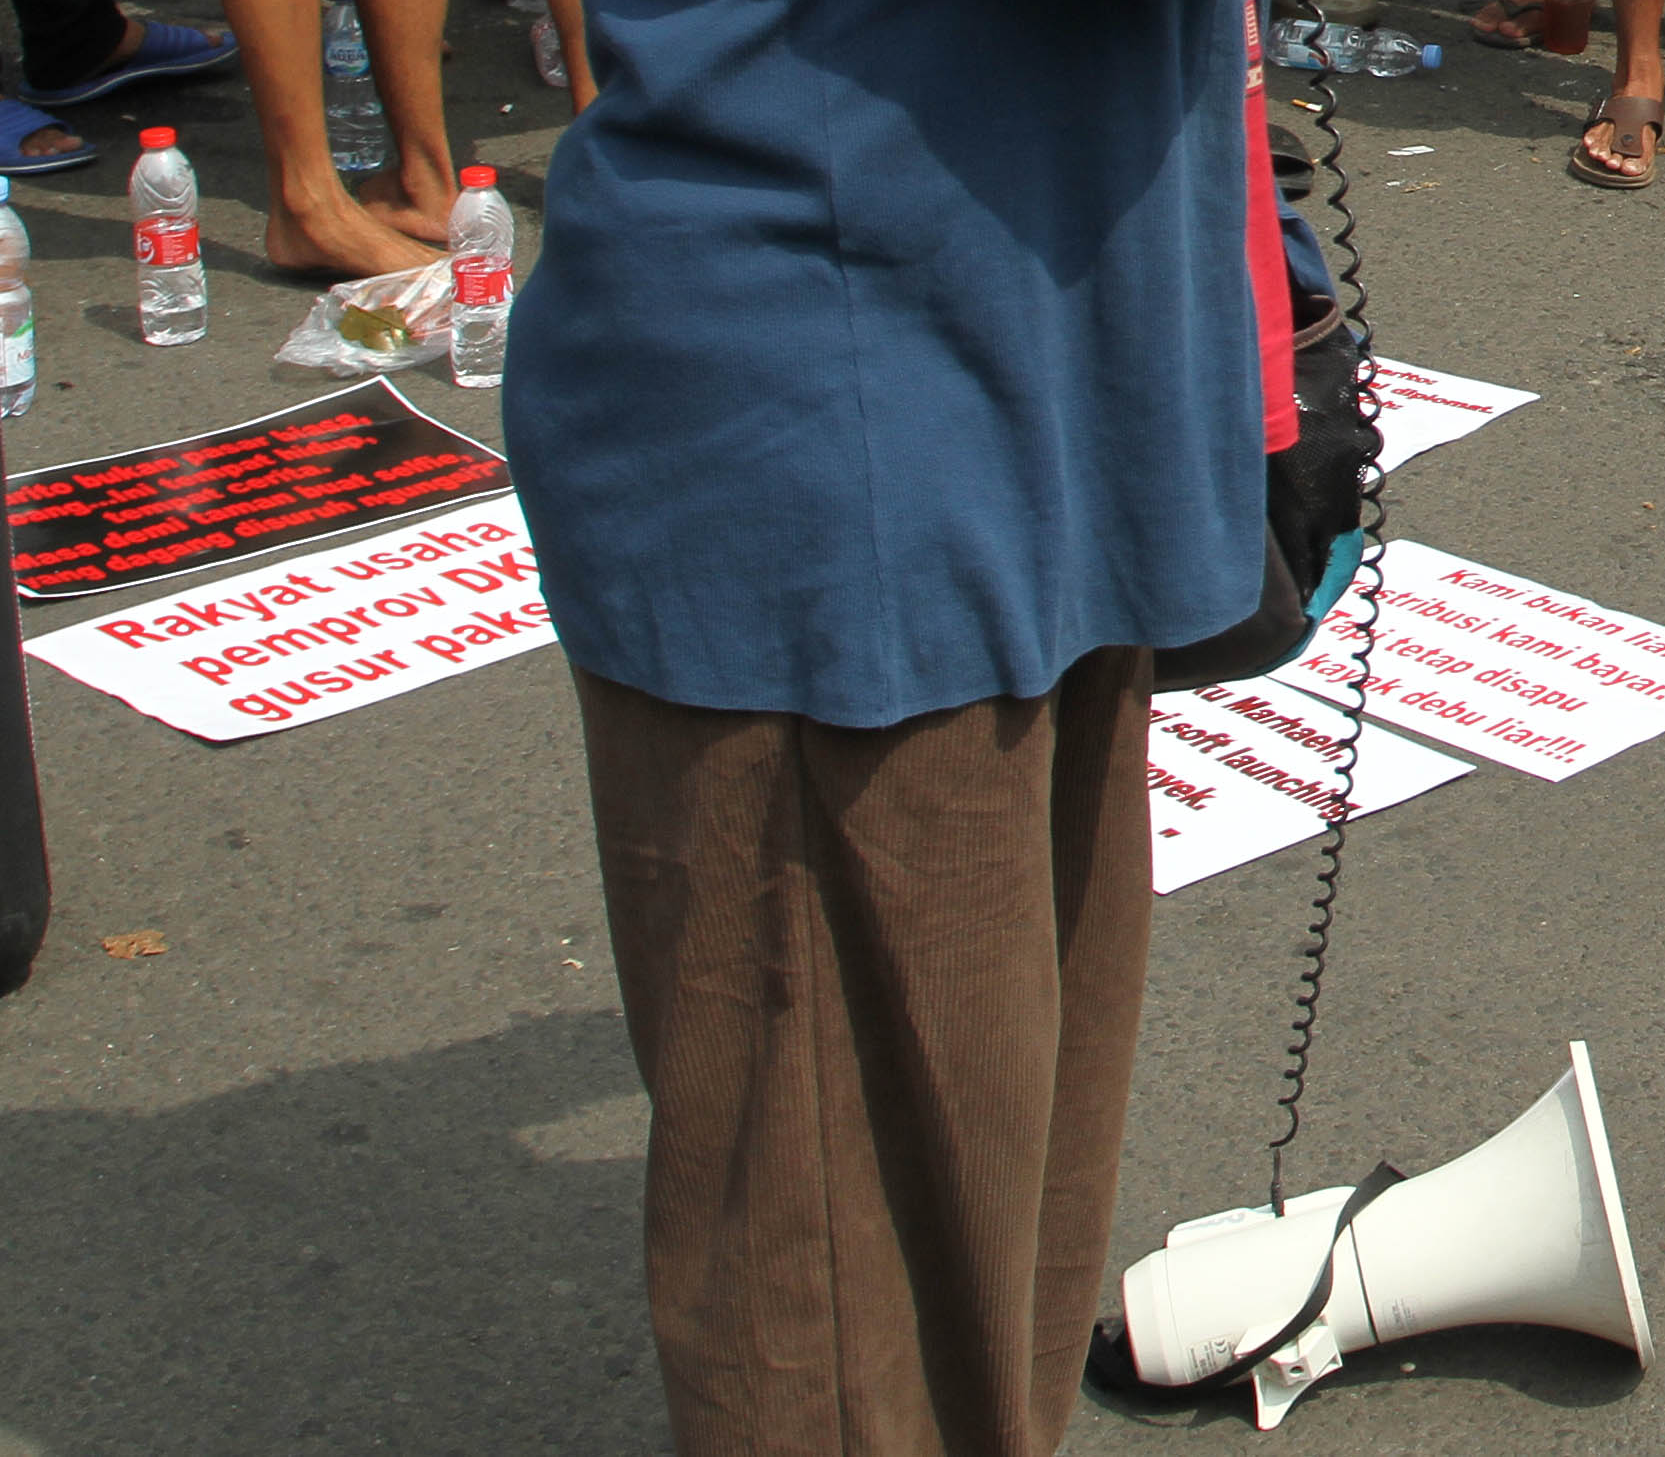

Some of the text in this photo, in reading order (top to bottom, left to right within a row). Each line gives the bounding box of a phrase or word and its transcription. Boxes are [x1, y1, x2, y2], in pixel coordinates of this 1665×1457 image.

[72, 458, 181, 489] bukan
[181, 436, 270, 467] pasar
[102, 464, 332, 524] tempat cerita.
[157, 454, 276, 490] tempat
[103, 516, 190, 549] demi
[188, 492, 297, 525] taman
[293, 472, 374, 499] buat
[106, 531, 236, 572] dagang
[234, 500, 359, 538] disuruh
[94, 521, 516, 650] Rakyat usaha
[179, 545, 540, 686] pemprov DK
[1438, 569, 1523, 600] Kami
[1524, 591, 1625, 639] bukan
[227, 600, 552, 723] gusur paks
[1320, 609, 1590, 715] Tapi tetap disapu
[1488, 621, 1587, 668] kami
[1160, 722, 1237, 754] soft
[1222, 695, 1347, 762] Marhaen,
[1299, 653, 1587, 764] kayak debu liar!!!
[1147, 760, 1216, 811] oyek.
